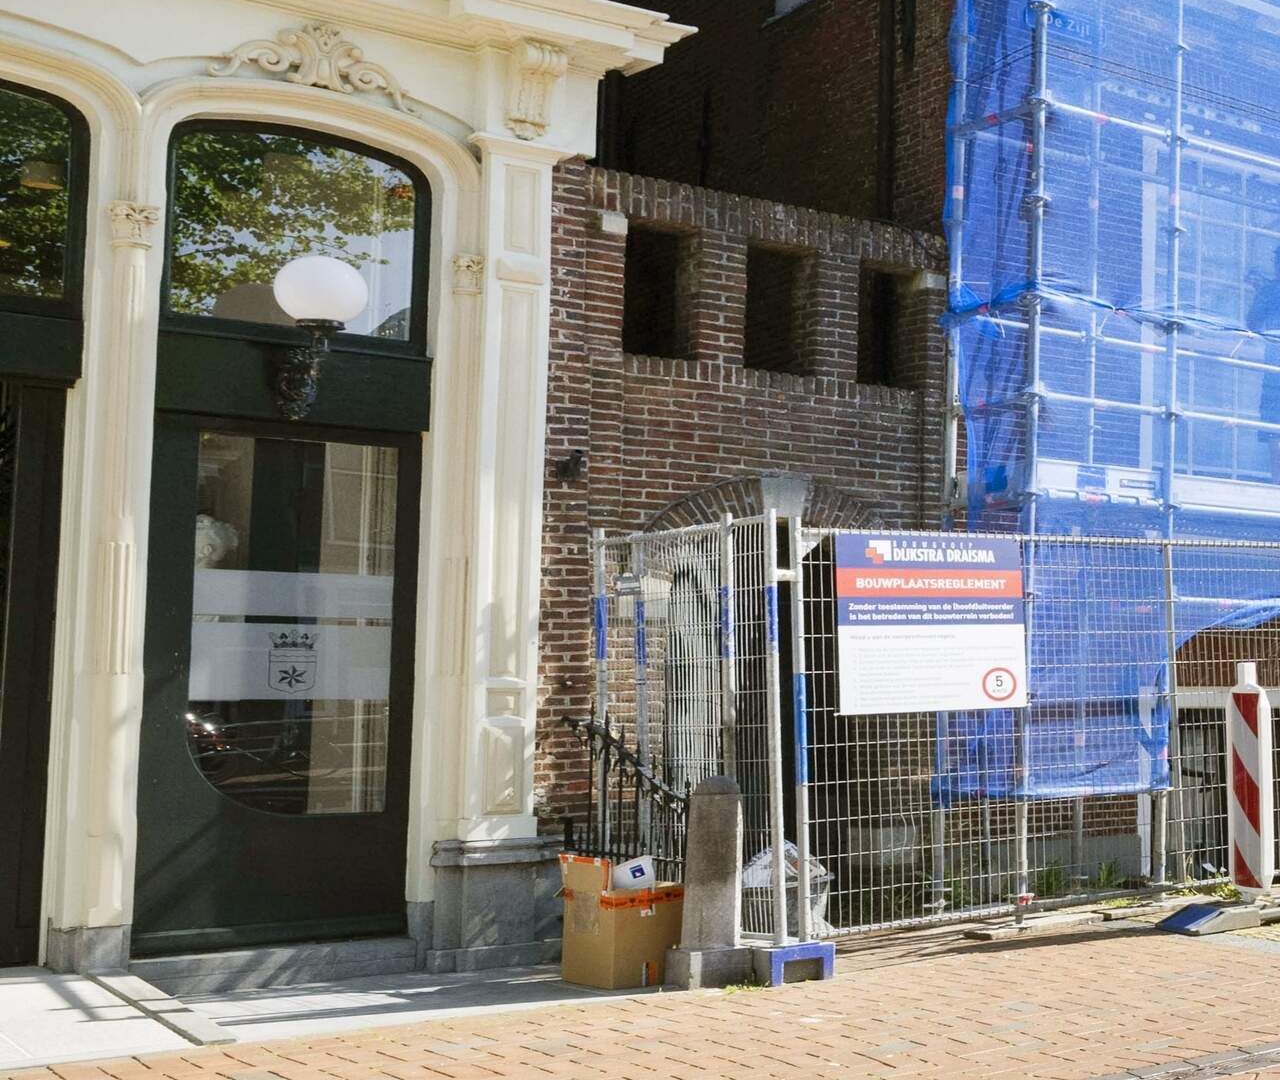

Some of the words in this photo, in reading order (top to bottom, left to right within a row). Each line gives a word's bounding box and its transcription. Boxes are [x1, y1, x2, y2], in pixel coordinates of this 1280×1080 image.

[1067, 19, 1090, 37] Zijl
[893, 547, 944, 563] DIJKSTRA
[946, 549, 995, 564] DRAISMA
[856, 577, 1007, 590] BOUWPLAATSREGLEMENT
[848, 602, 876, 611] Zonder
[877, 602, 927, 612] toestemming
[943, 602, 953, 610] de
[849, 612, 857, 620] is
[858, 612, 871, 621] het
[873, 612, 907, 621] betreden
[922, 611, 933, 620] dit
[934, 612, 978, 620] bouwterrein
[995, 675, 1004, 688] 5
